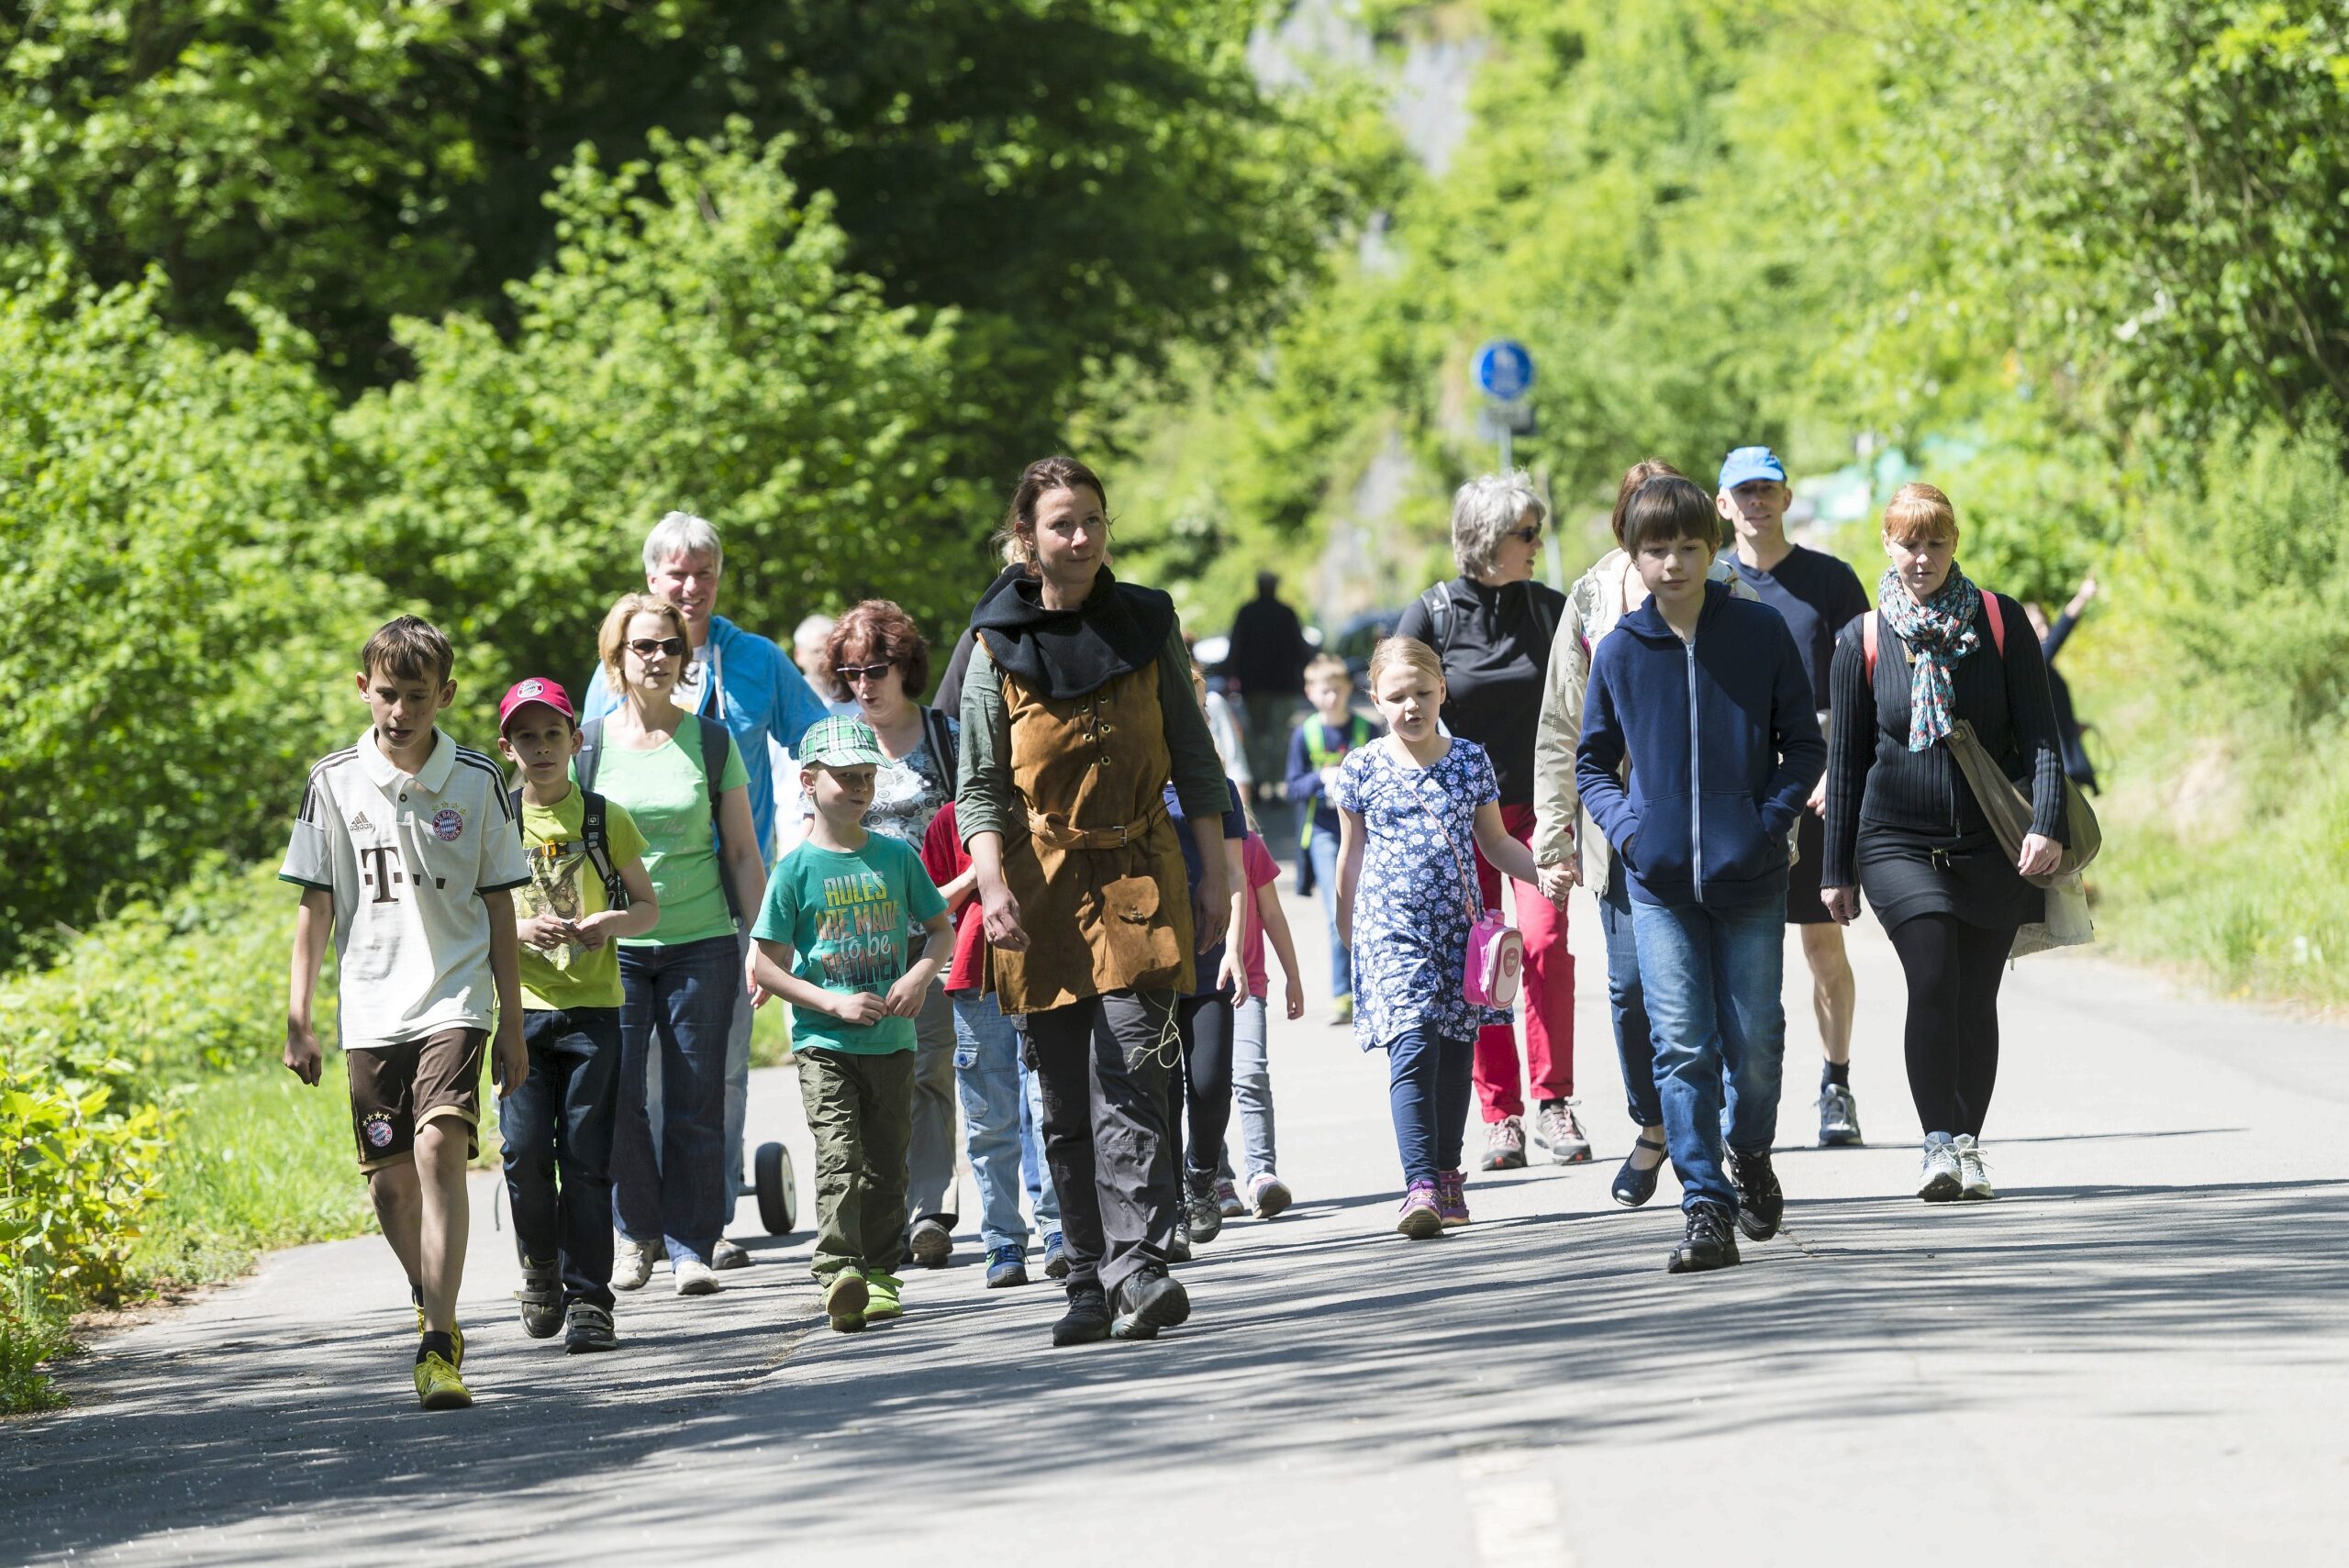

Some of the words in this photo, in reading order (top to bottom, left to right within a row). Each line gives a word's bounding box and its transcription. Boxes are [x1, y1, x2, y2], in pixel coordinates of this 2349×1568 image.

[350, 823, 373, 831] adidas
[823, 872, 888, 906] RULES
[815, 908, 852, 940] ARE
[834, 931, 862, 961] to
[866, 921, 891, 957] be
